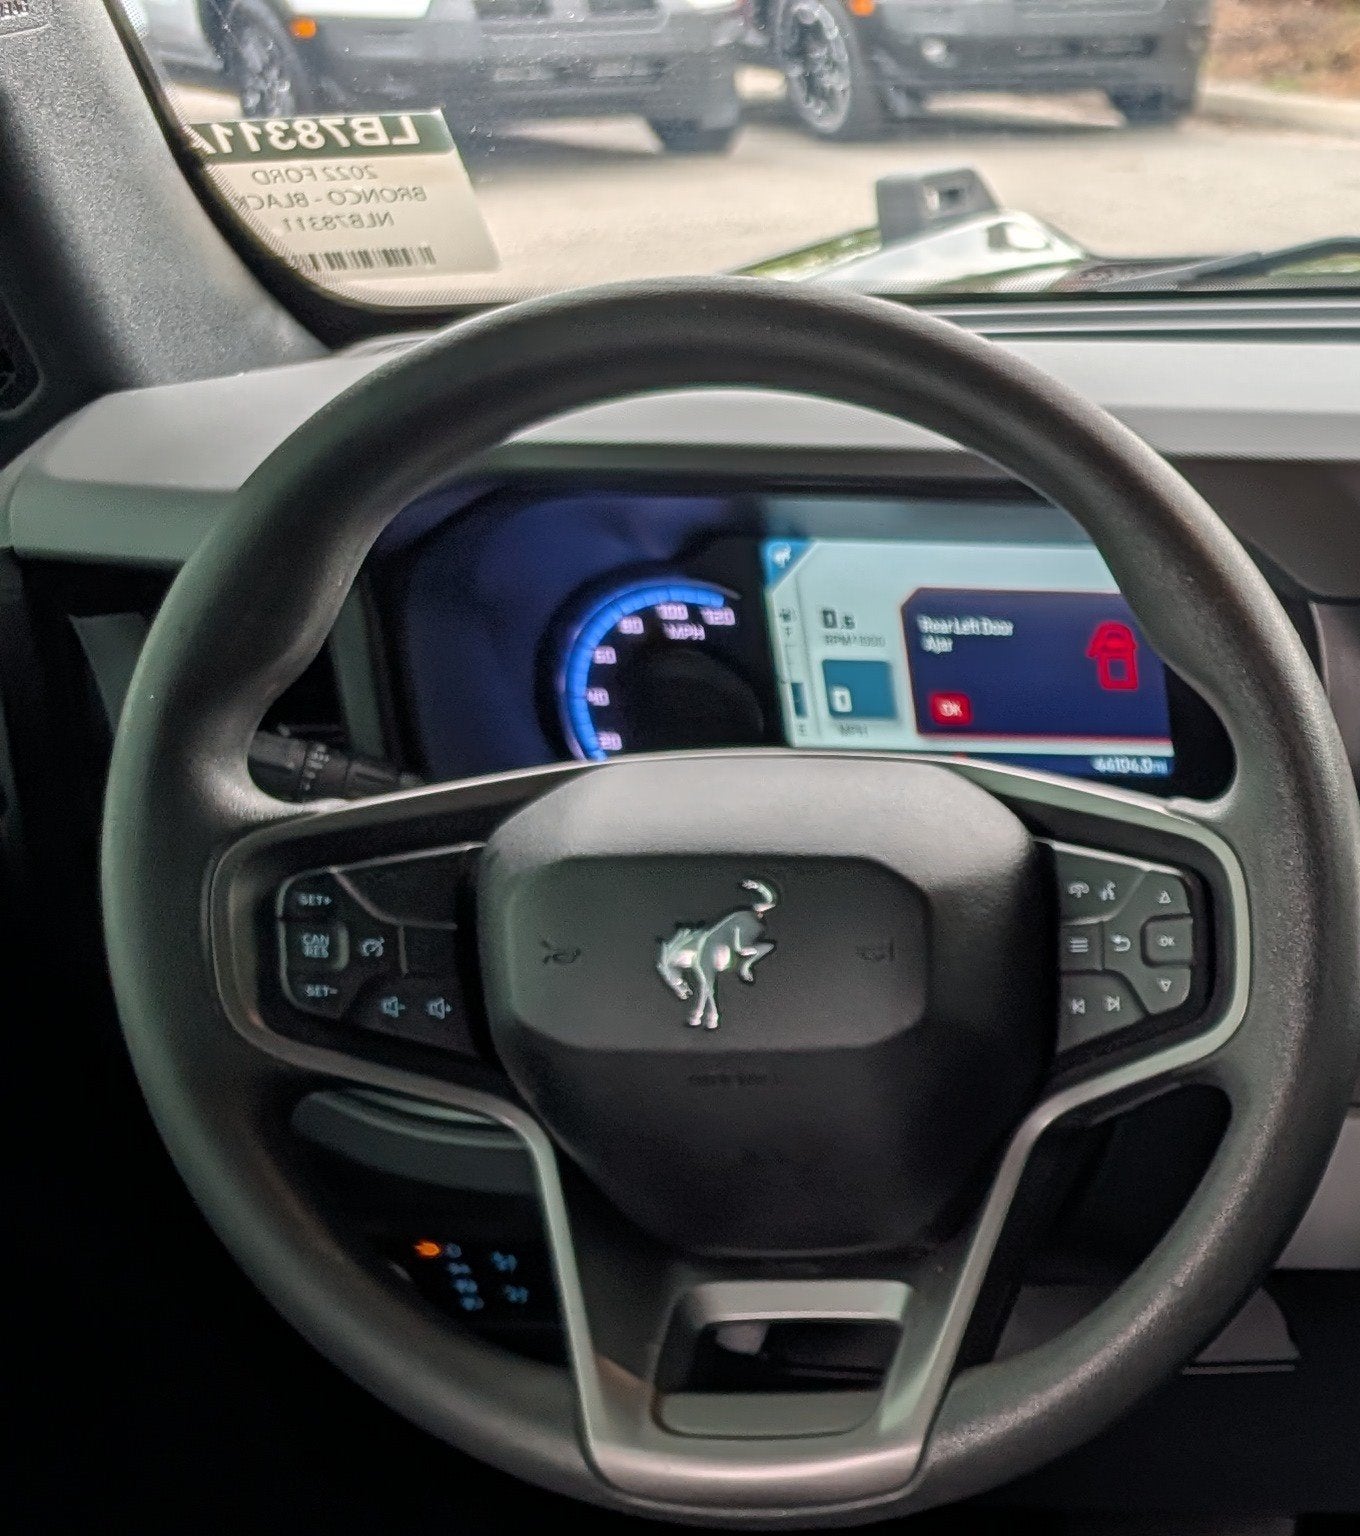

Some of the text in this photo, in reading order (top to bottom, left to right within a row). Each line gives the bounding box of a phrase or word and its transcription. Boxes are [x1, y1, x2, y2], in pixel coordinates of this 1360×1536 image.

[954, 616, 979, 635] Left
[980, 618, 1014, 636] Door
[1158, 934, 1176, 947] OK
